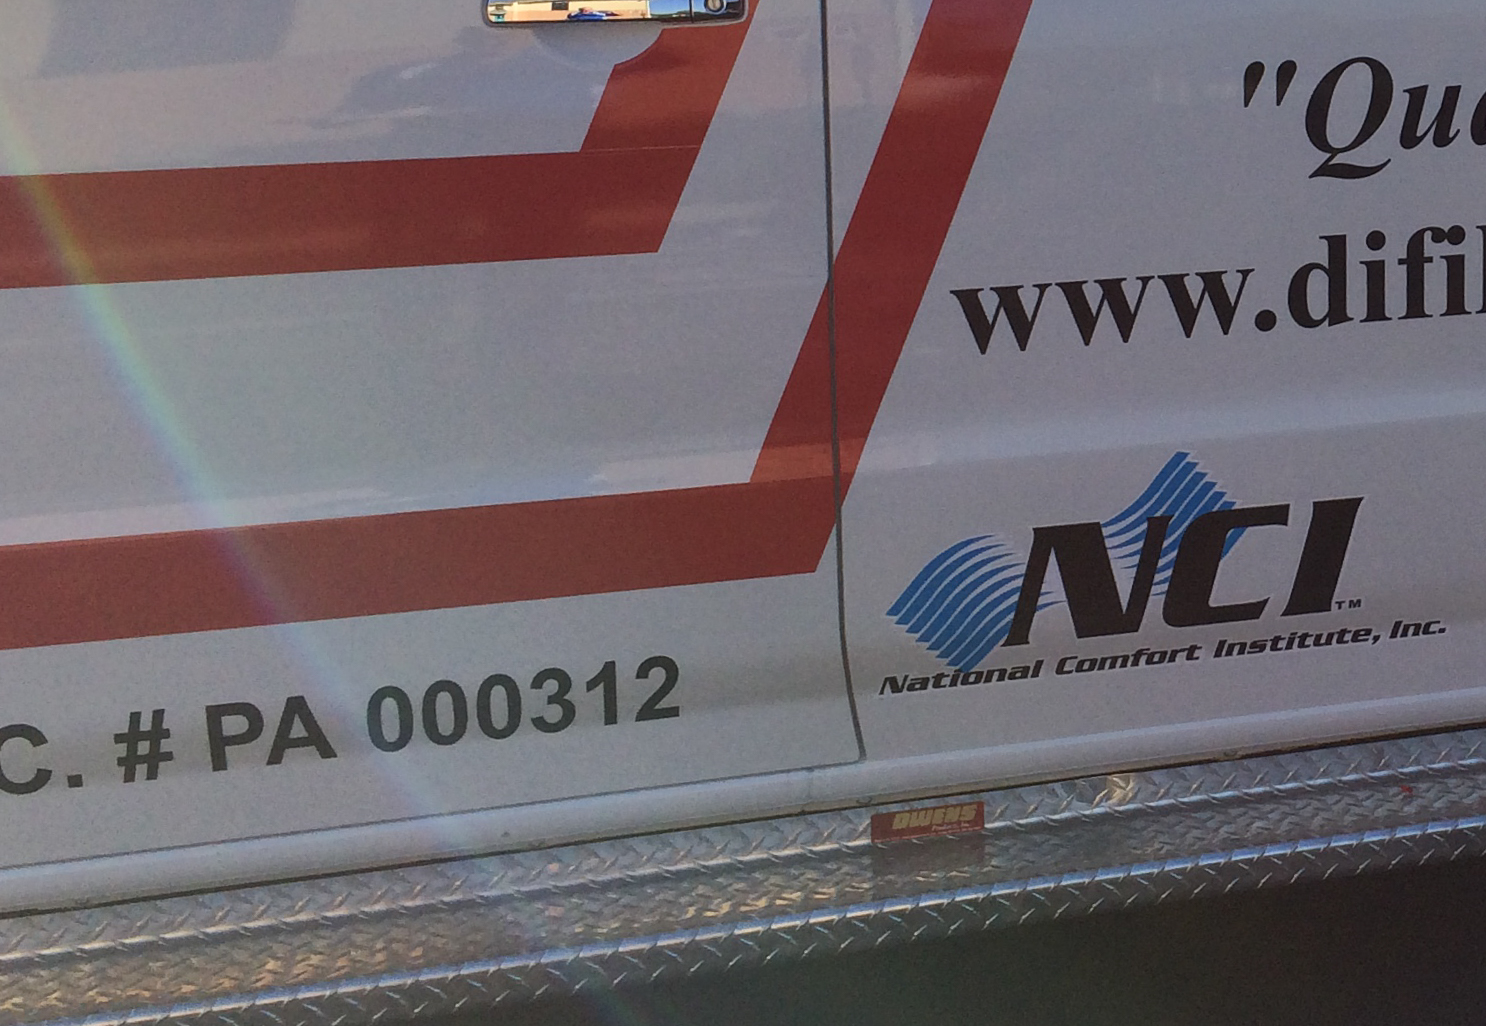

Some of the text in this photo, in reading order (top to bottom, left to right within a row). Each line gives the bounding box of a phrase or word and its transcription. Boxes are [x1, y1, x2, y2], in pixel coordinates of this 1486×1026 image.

[1000, 496, 1366, 648] NCI
[113, 707, 174, 784] #
[205, 694, 338, 773] PA
[366, 654, 681, 753] 000312
[878, 618, 1448, 696] National Comfort Institute, Inc.
